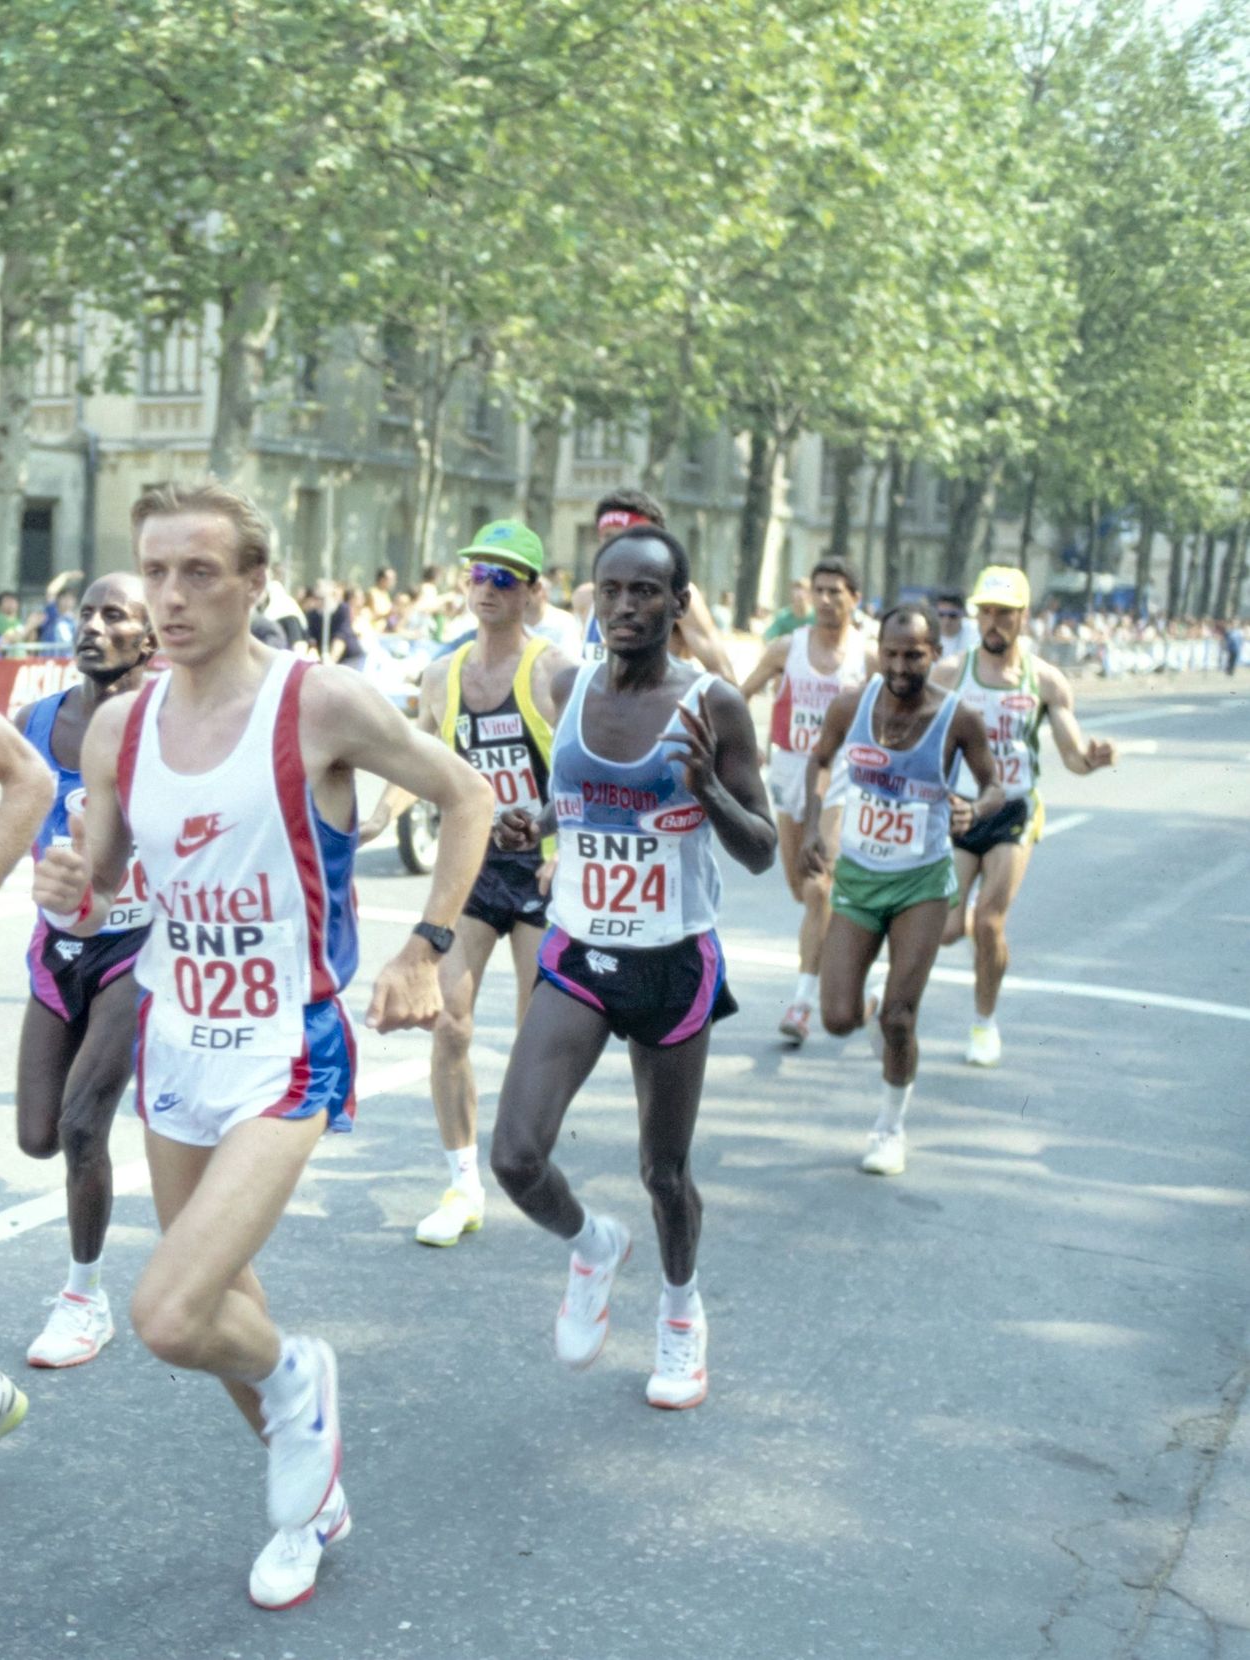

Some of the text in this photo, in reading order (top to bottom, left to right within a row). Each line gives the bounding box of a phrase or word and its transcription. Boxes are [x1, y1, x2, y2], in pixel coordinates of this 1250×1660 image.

[481, 717, 519, 736] Vittel
[469, 746, 527, 770] BNP
[859, 803, 914, 845] 025
[577, 832, 659, 862] BNP
[156, 872, 274, 923] Vittel
[582, 862, 666, 913] 024
[108, 908, 143, 926] DF
[588, 918, 645, 938] EDF
[167, 919, 265, 957] BNP
[174, 955, 279, 1020] 028
[190, 1024, 256, 1050] EDF
